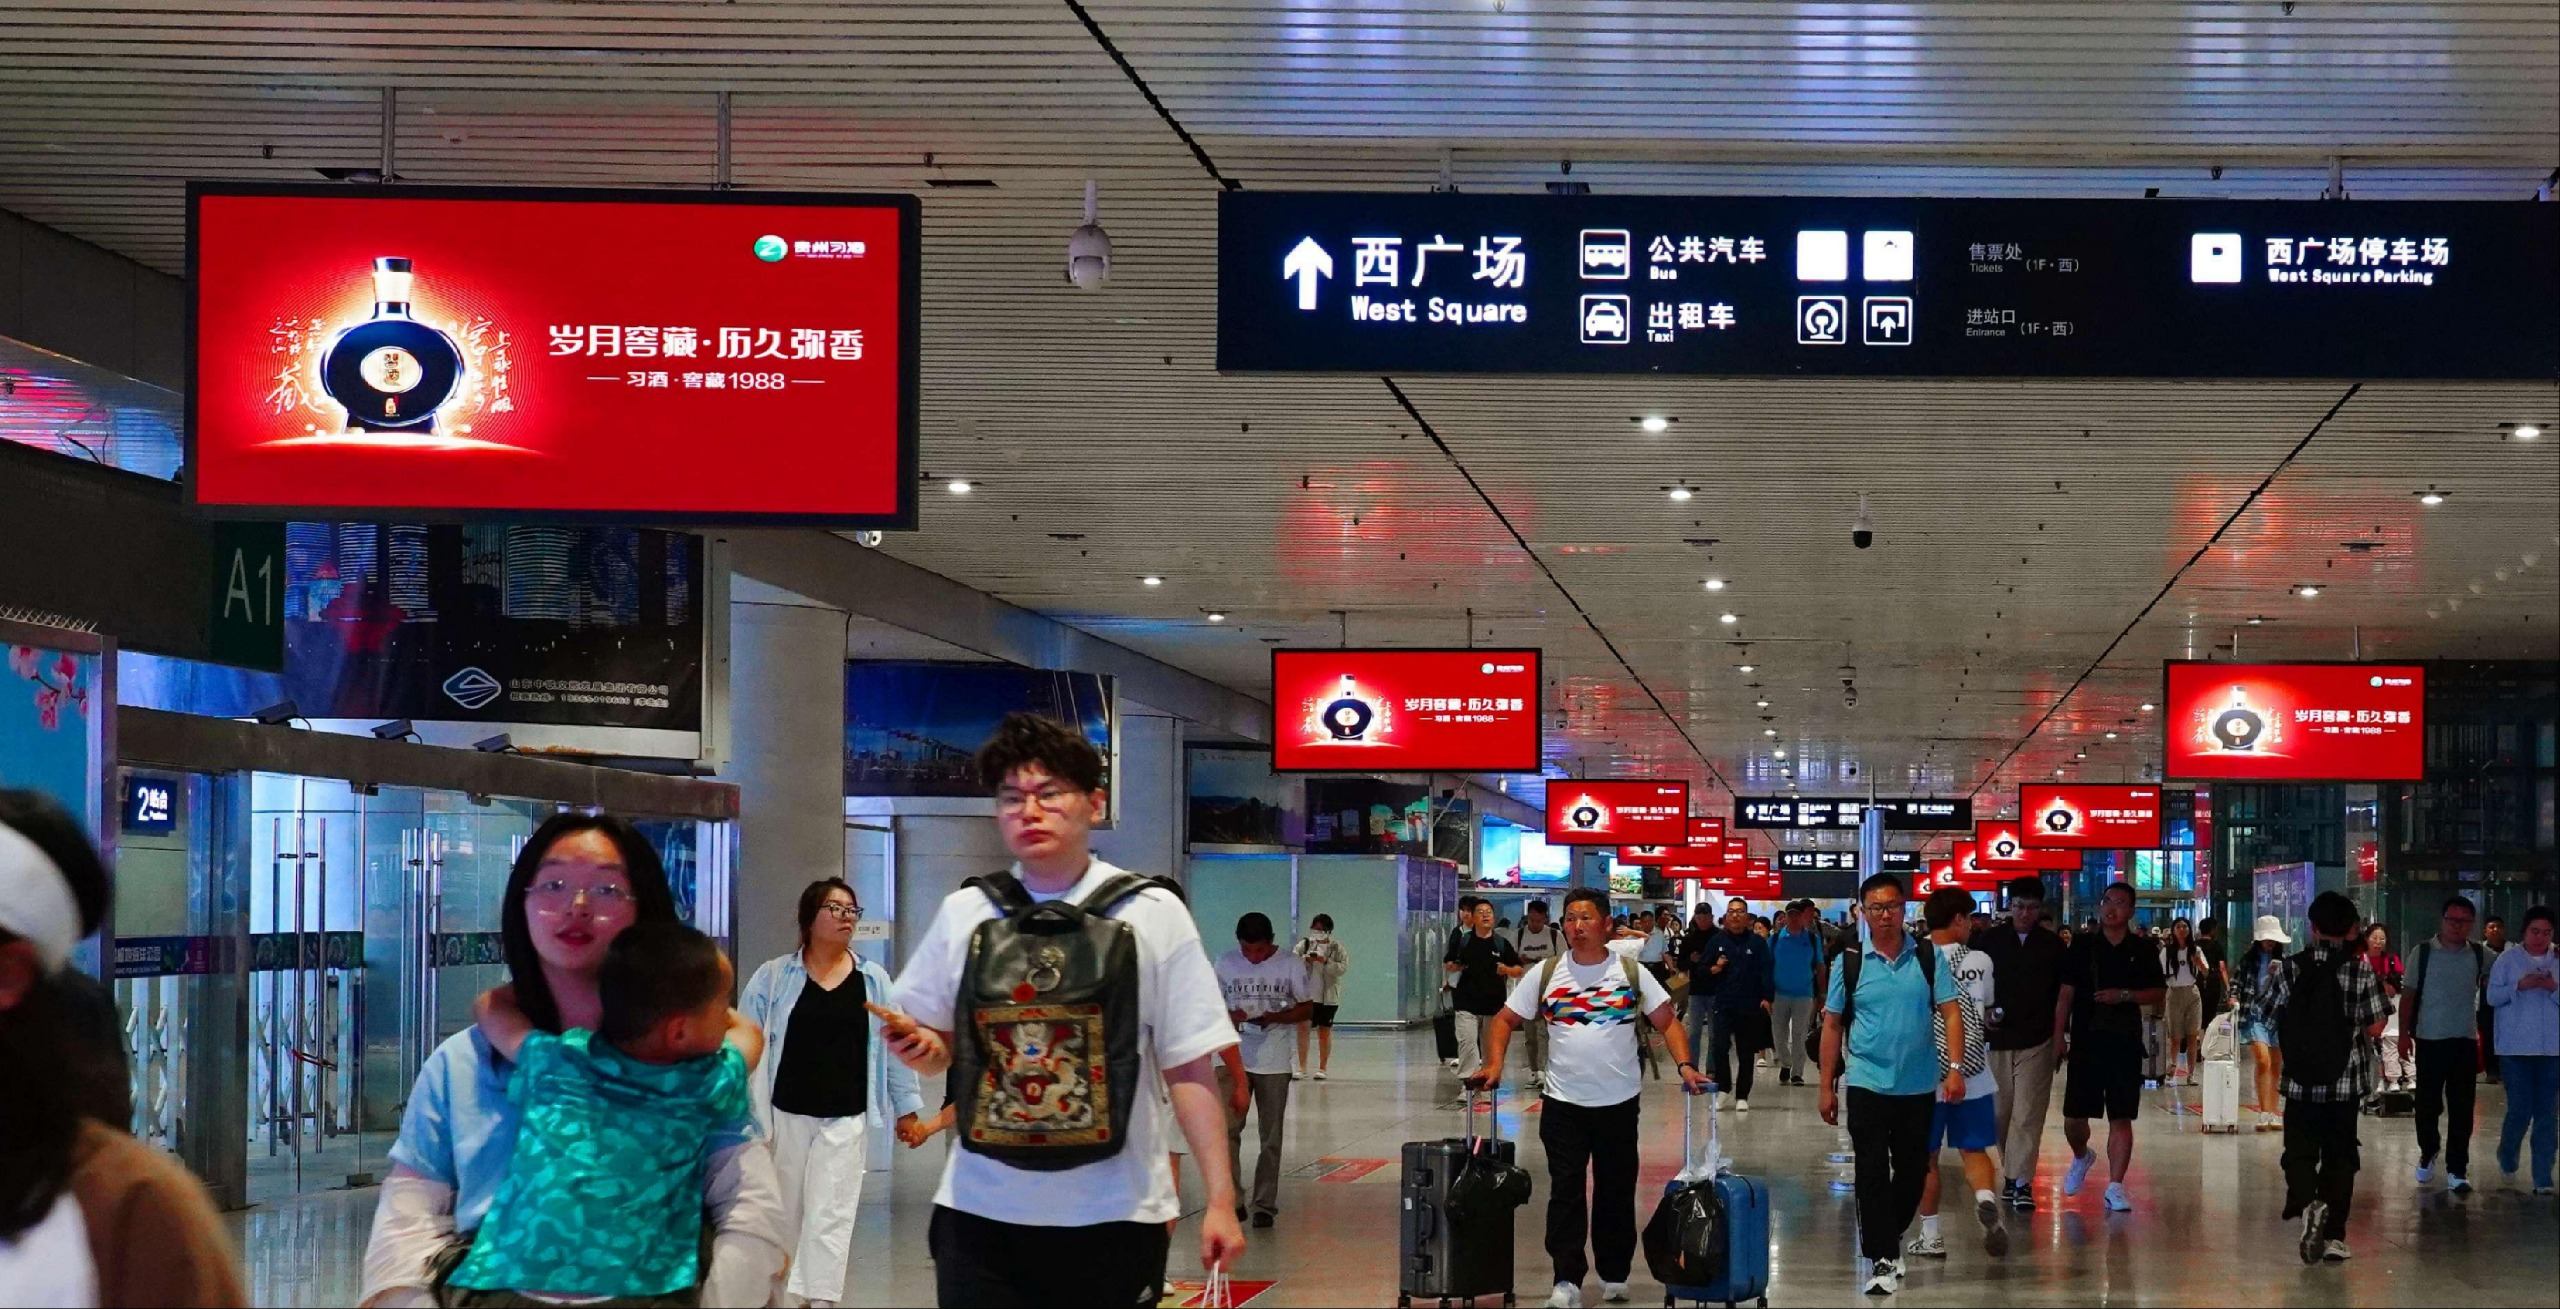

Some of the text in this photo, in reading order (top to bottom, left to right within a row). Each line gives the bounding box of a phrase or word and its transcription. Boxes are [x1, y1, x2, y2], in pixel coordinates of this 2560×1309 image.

[1647, 234, 1767, 264] 公共汽车
[1968, 242, 2023, 262] 售票处
[2265, 236, 2449, 266] 西广场停车场
[1351, 234, 1527, 288] 西广场
[1969, 262, 2004, 274] Tickets
[1649, 265, 1678, 280] Bus
[2268, 268, 2434, 286] West Square Parking
[1351, 295, 1528, 326] West Square
[1648, 301, 1737, 330] 出租车
[1967, 307, 2017, 326] 进站口
[1646, 329, 1675, 343] Taxi
[1965, 326, 2007, 338] Entrance
[224, 547, 272, 626] A1
